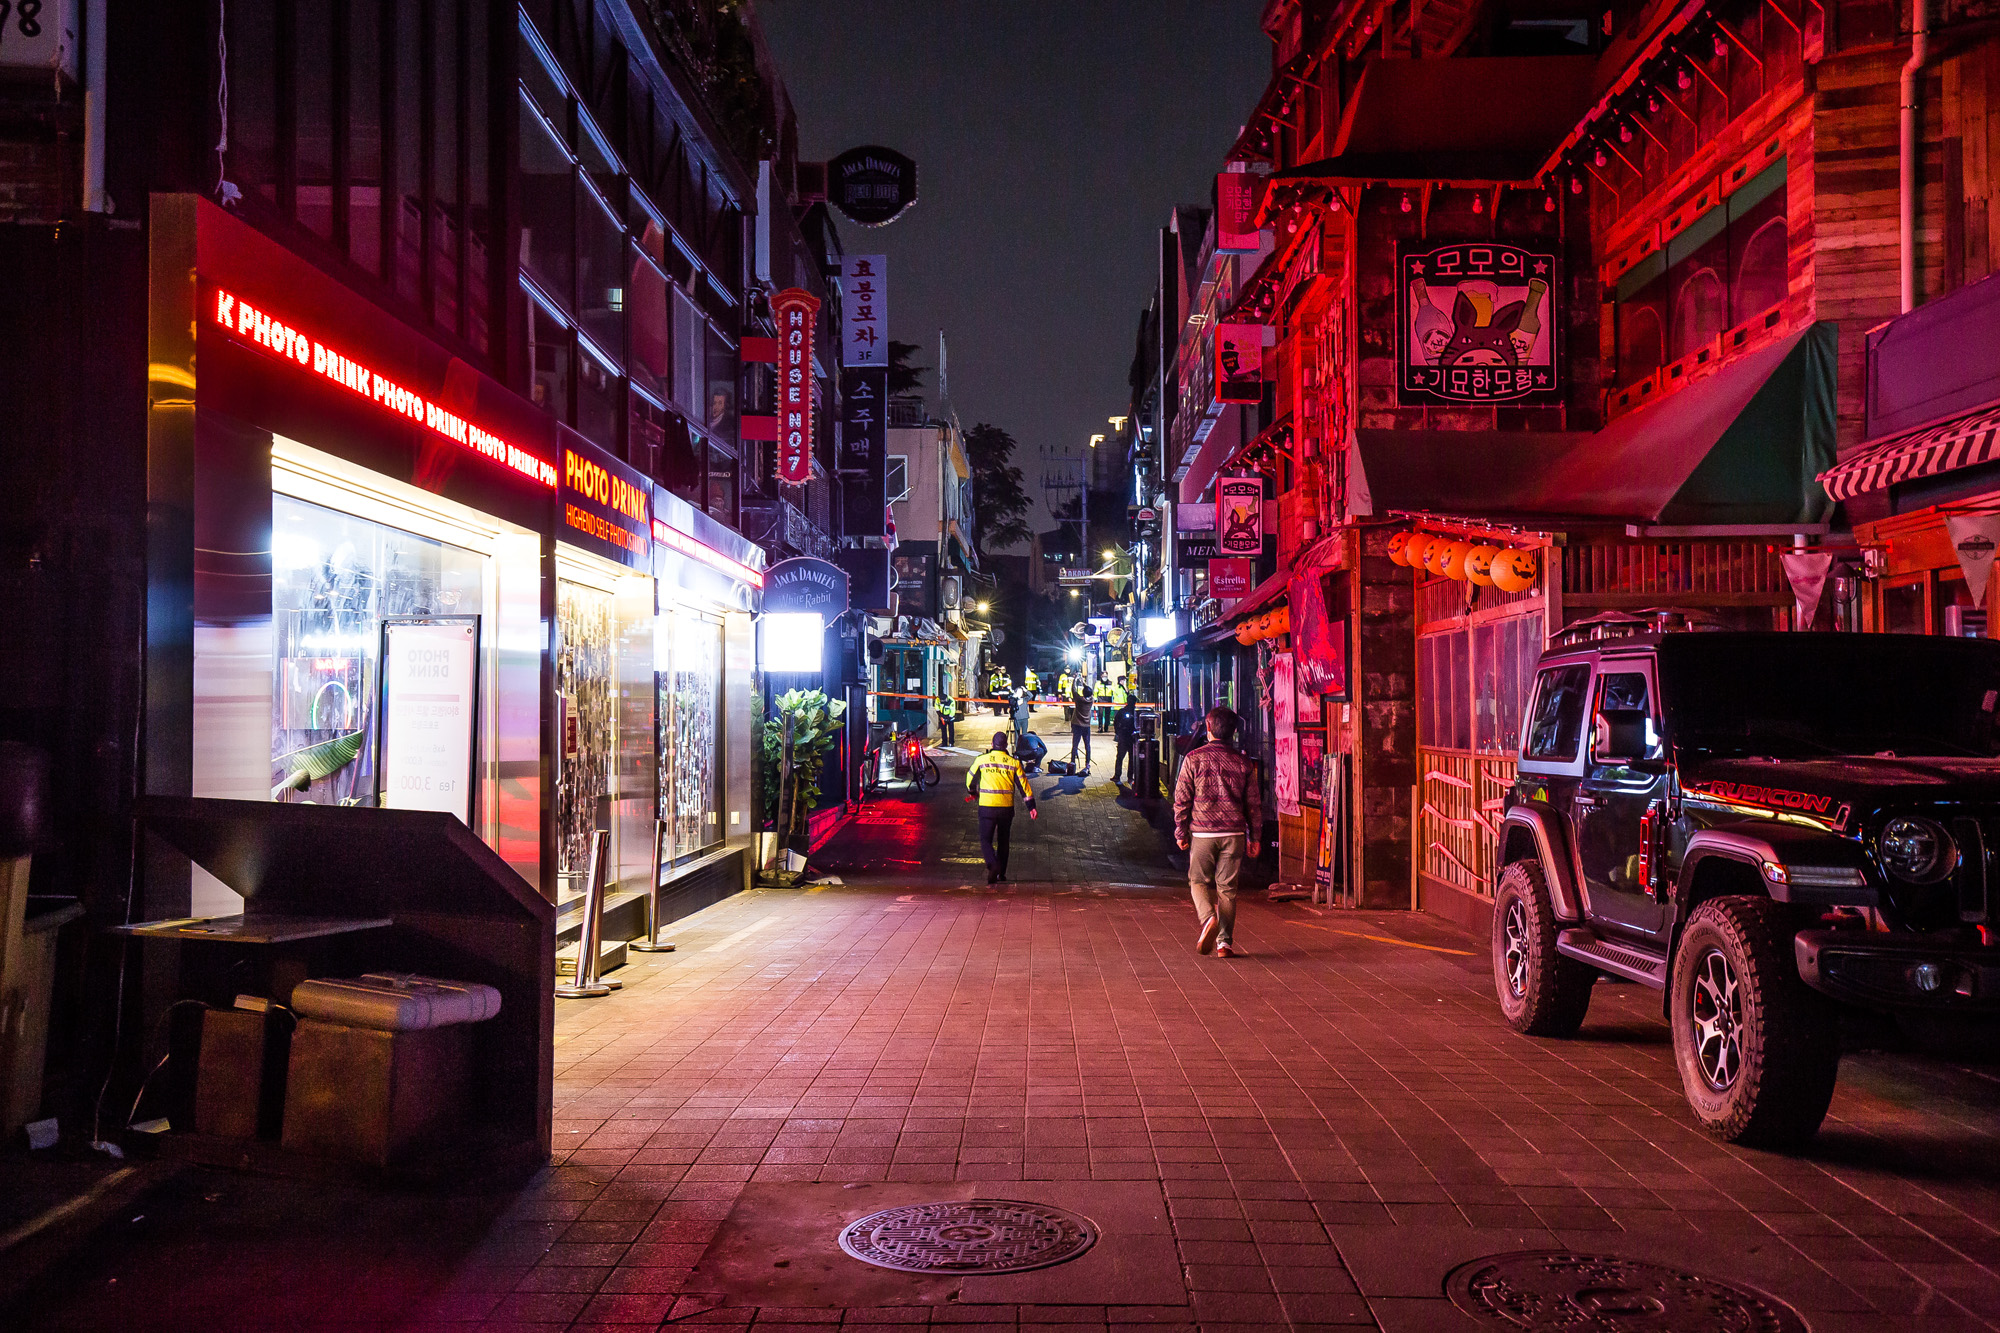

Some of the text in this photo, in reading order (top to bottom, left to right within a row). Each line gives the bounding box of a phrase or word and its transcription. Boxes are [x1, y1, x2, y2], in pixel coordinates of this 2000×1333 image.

[1435, 249, 1524, 277] 모모의
[788, 310, 802, 403] HOUSE
[858, 351, 872, 360] 3F
[217, 290, 234, 329] K
[238, 302, 310, 365] PHOTO
[314, 342, 370, 396] DRINK
[373, 373, 424, 423] PHOTO
[426, 402, 467, 444] DRINK
[469, 424, 506, 463] PHOTO
[507, 444, 539, 477] DRINK
[1428, 368, 1532, 398] 기묘한모험
[566, 449, 647, 524] PHOTO DRINK
[1229, 486, 1255, 495] 모모의
[566, 503, 647, 557] HIGHEND SELF PHOTO STUDIO
[774, 566, 837, 590] JACK DANIEL'S
[1213, 575, 1246, 585] Estrella
[1709, 780, 1832, 813] RUBICON
